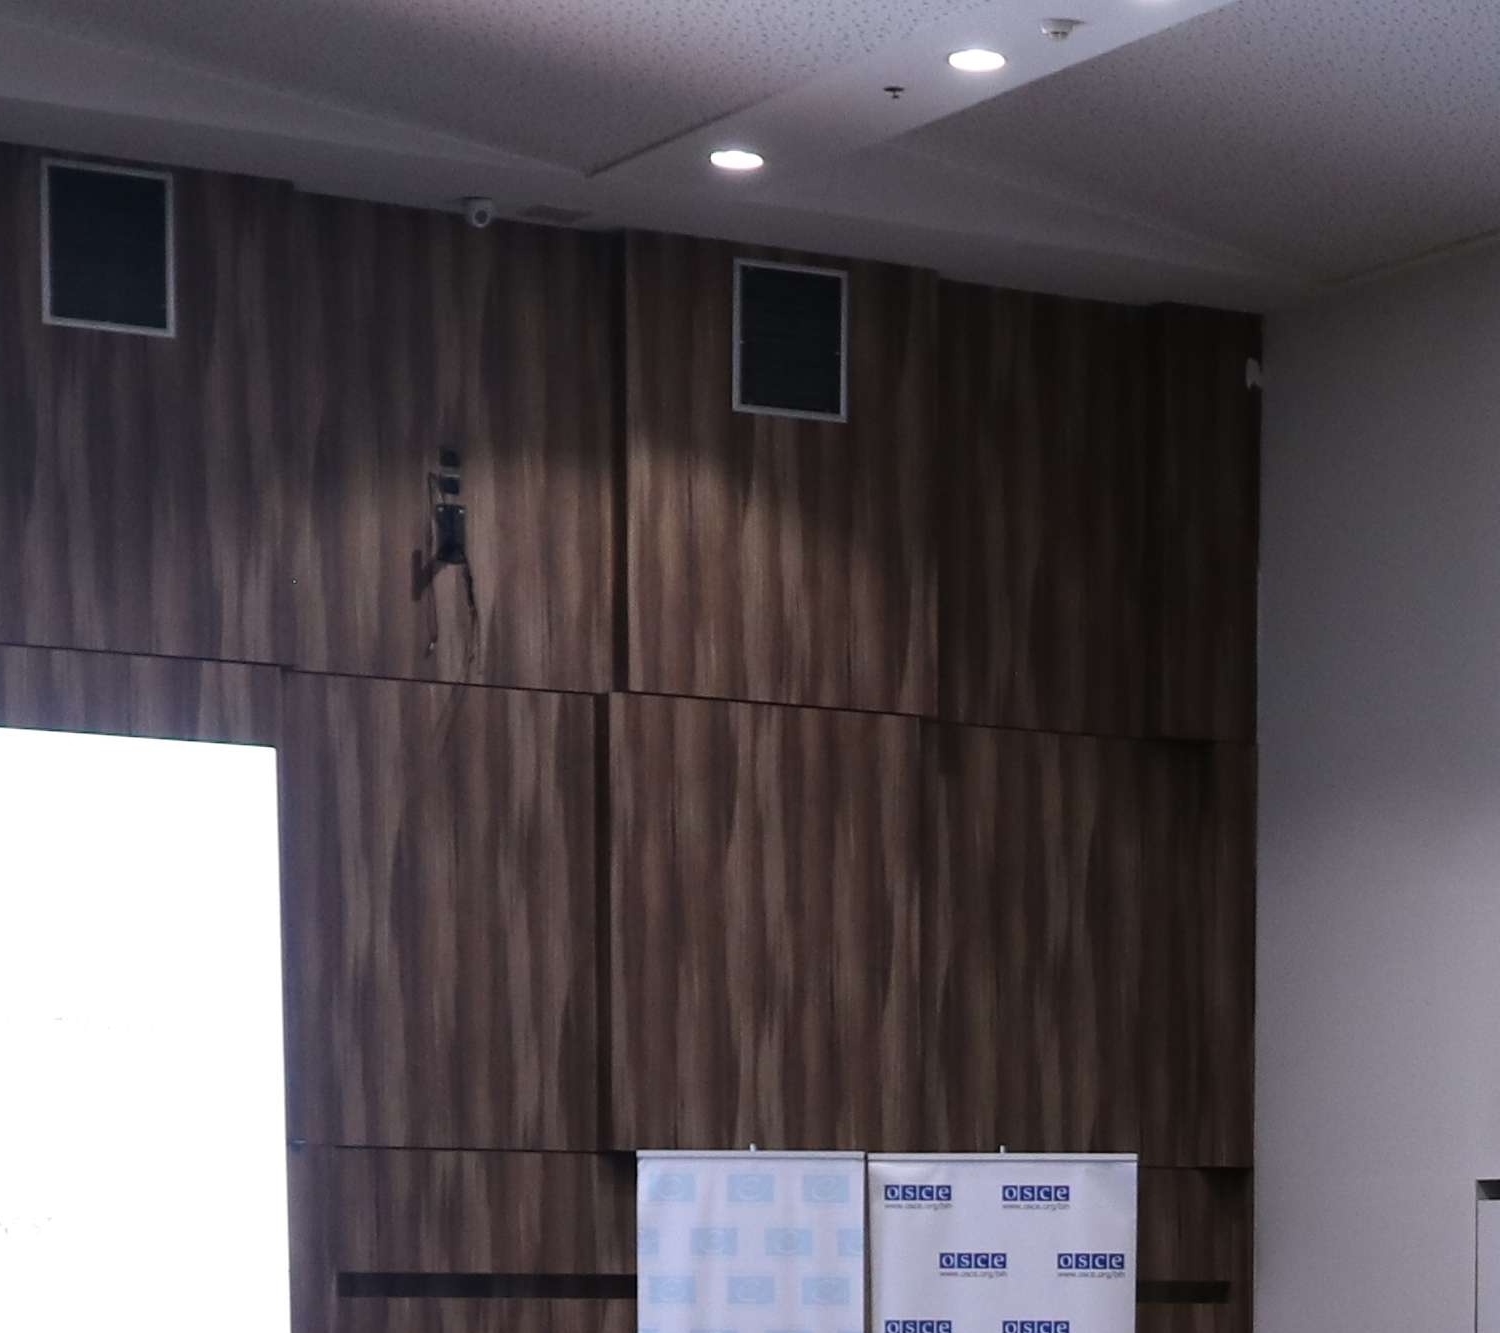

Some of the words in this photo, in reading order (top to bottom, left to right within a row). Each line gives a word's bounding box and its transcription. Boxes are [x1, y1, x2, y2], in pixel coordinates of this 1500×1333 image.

[885, 1185, 951, 1201] osce
[1003, 1186, 1069, 1201] osce
[940, 1253, 1006, 1268] osce
[1058, 1253, 1124, 1269] osce
